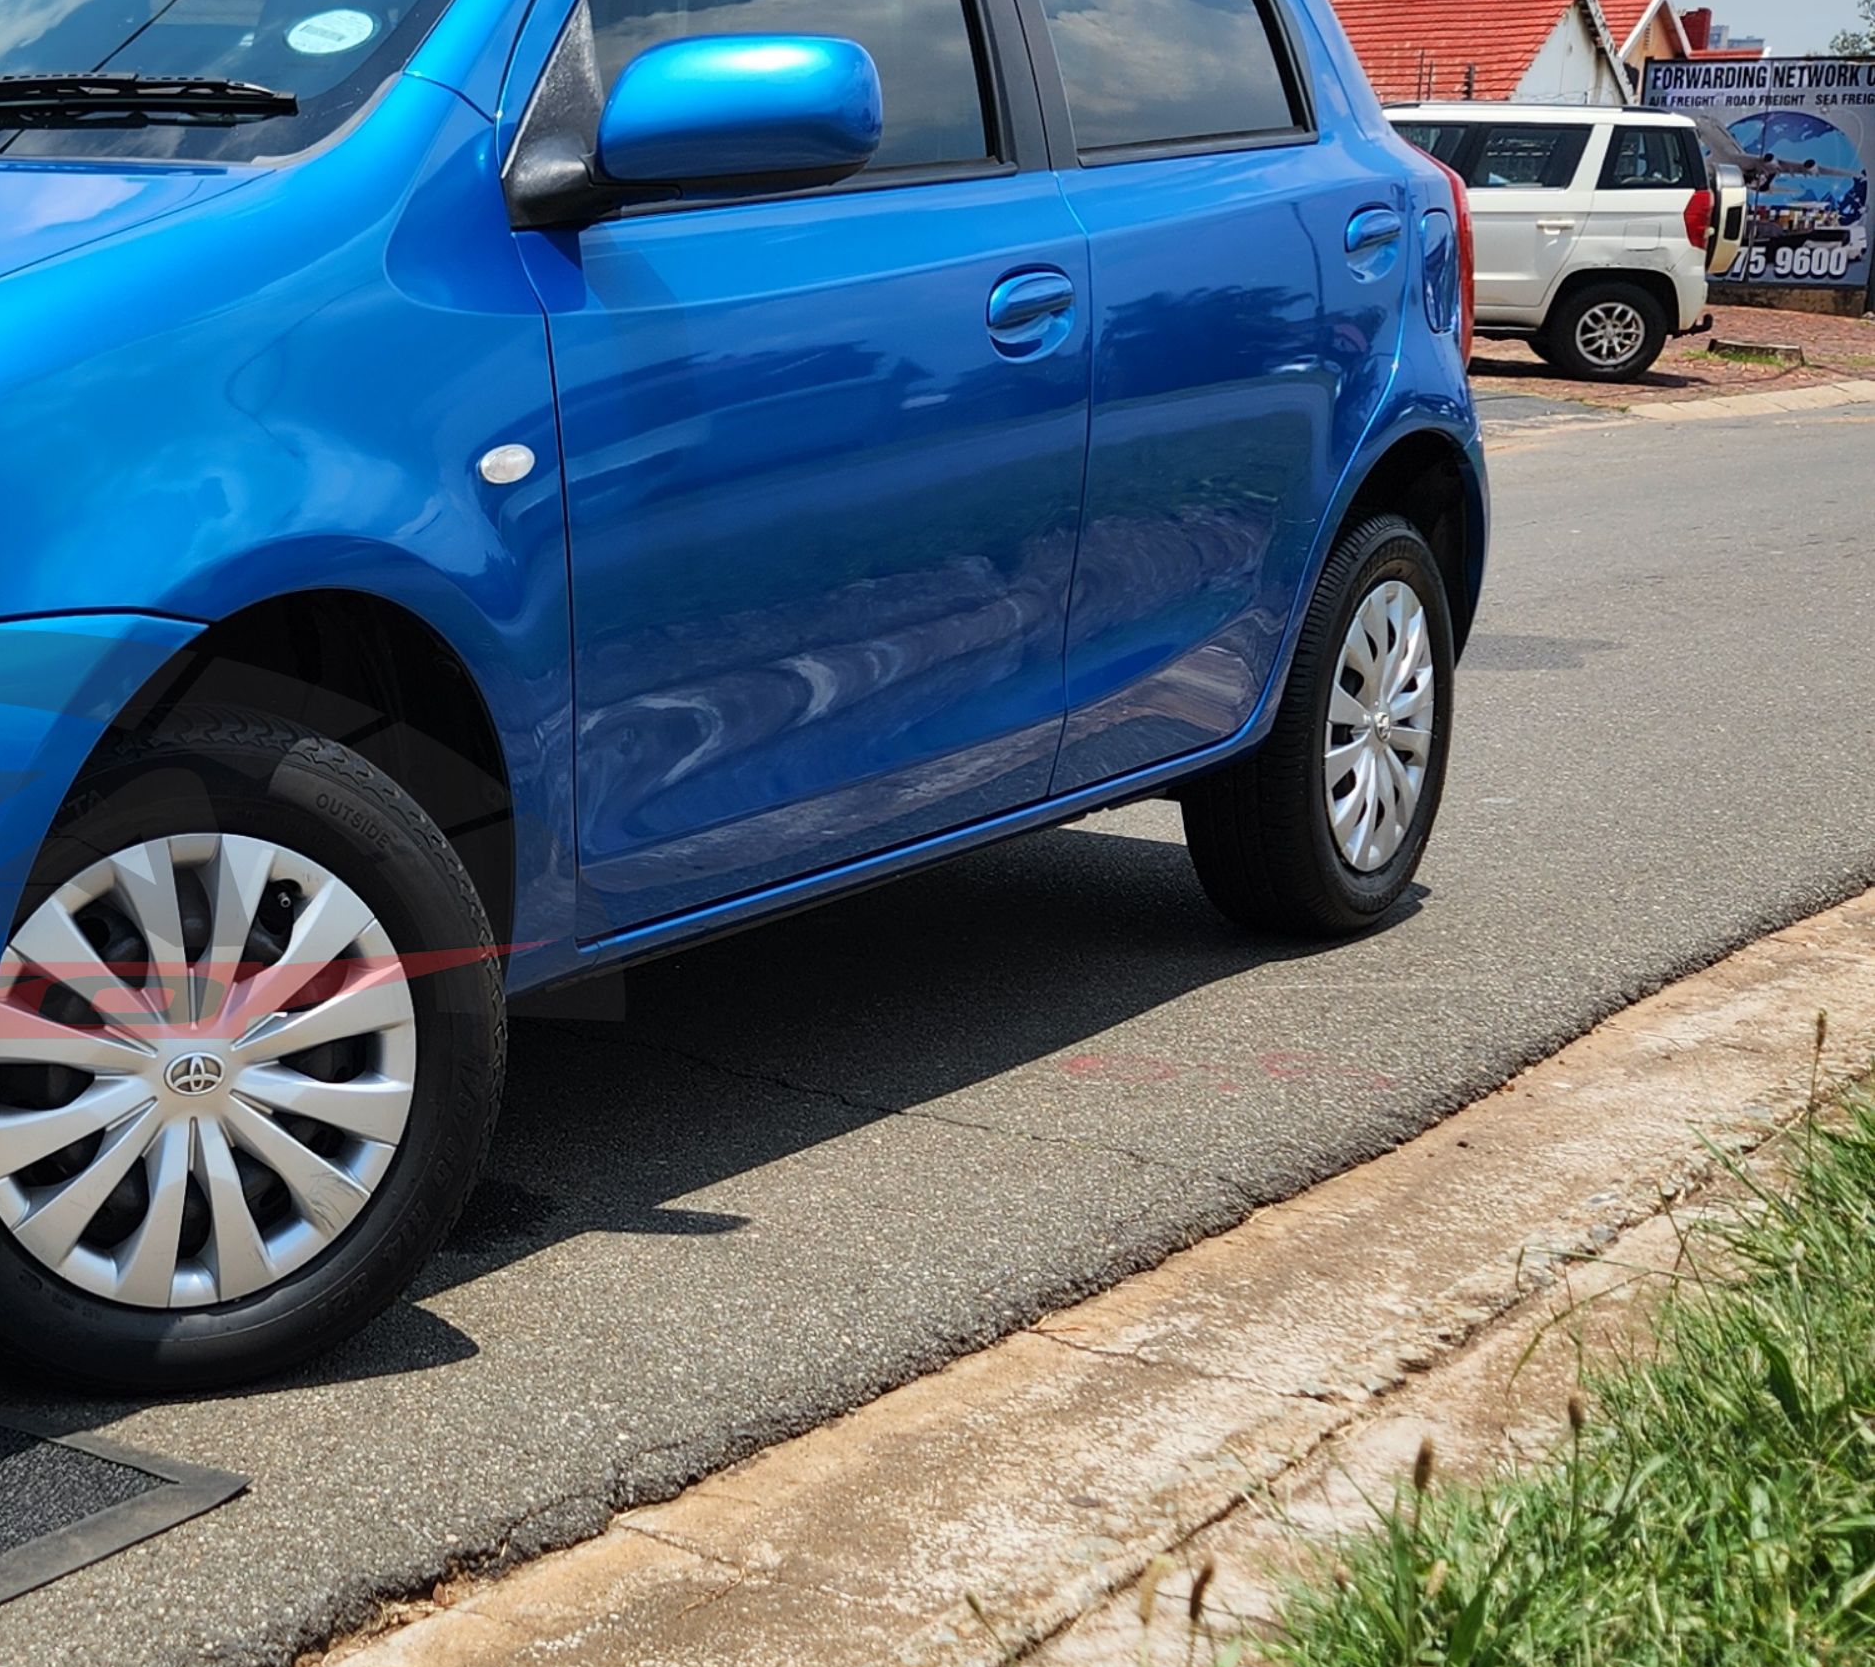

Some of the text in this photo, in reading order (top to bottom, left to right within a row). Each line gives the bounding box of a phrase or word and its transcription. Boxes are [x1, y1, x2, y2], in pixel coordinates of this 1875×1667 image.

[1651, 65, 1768, 90] FORWARDING
[1772, 63, 1861, 88] NETWORK
[1649, 95, 1668, 107] AIR
[1670, 94, 1716, 107] FREIGHT
[1726, 94, 1756, 107] ROAD
[1759, 94, 1805, 107] FREIGHT
[1815, 93, 1838, 106] SEA
[1774, 246, 1848, 277] 9600
[316, 793, 391, 848] OUTSIDE
